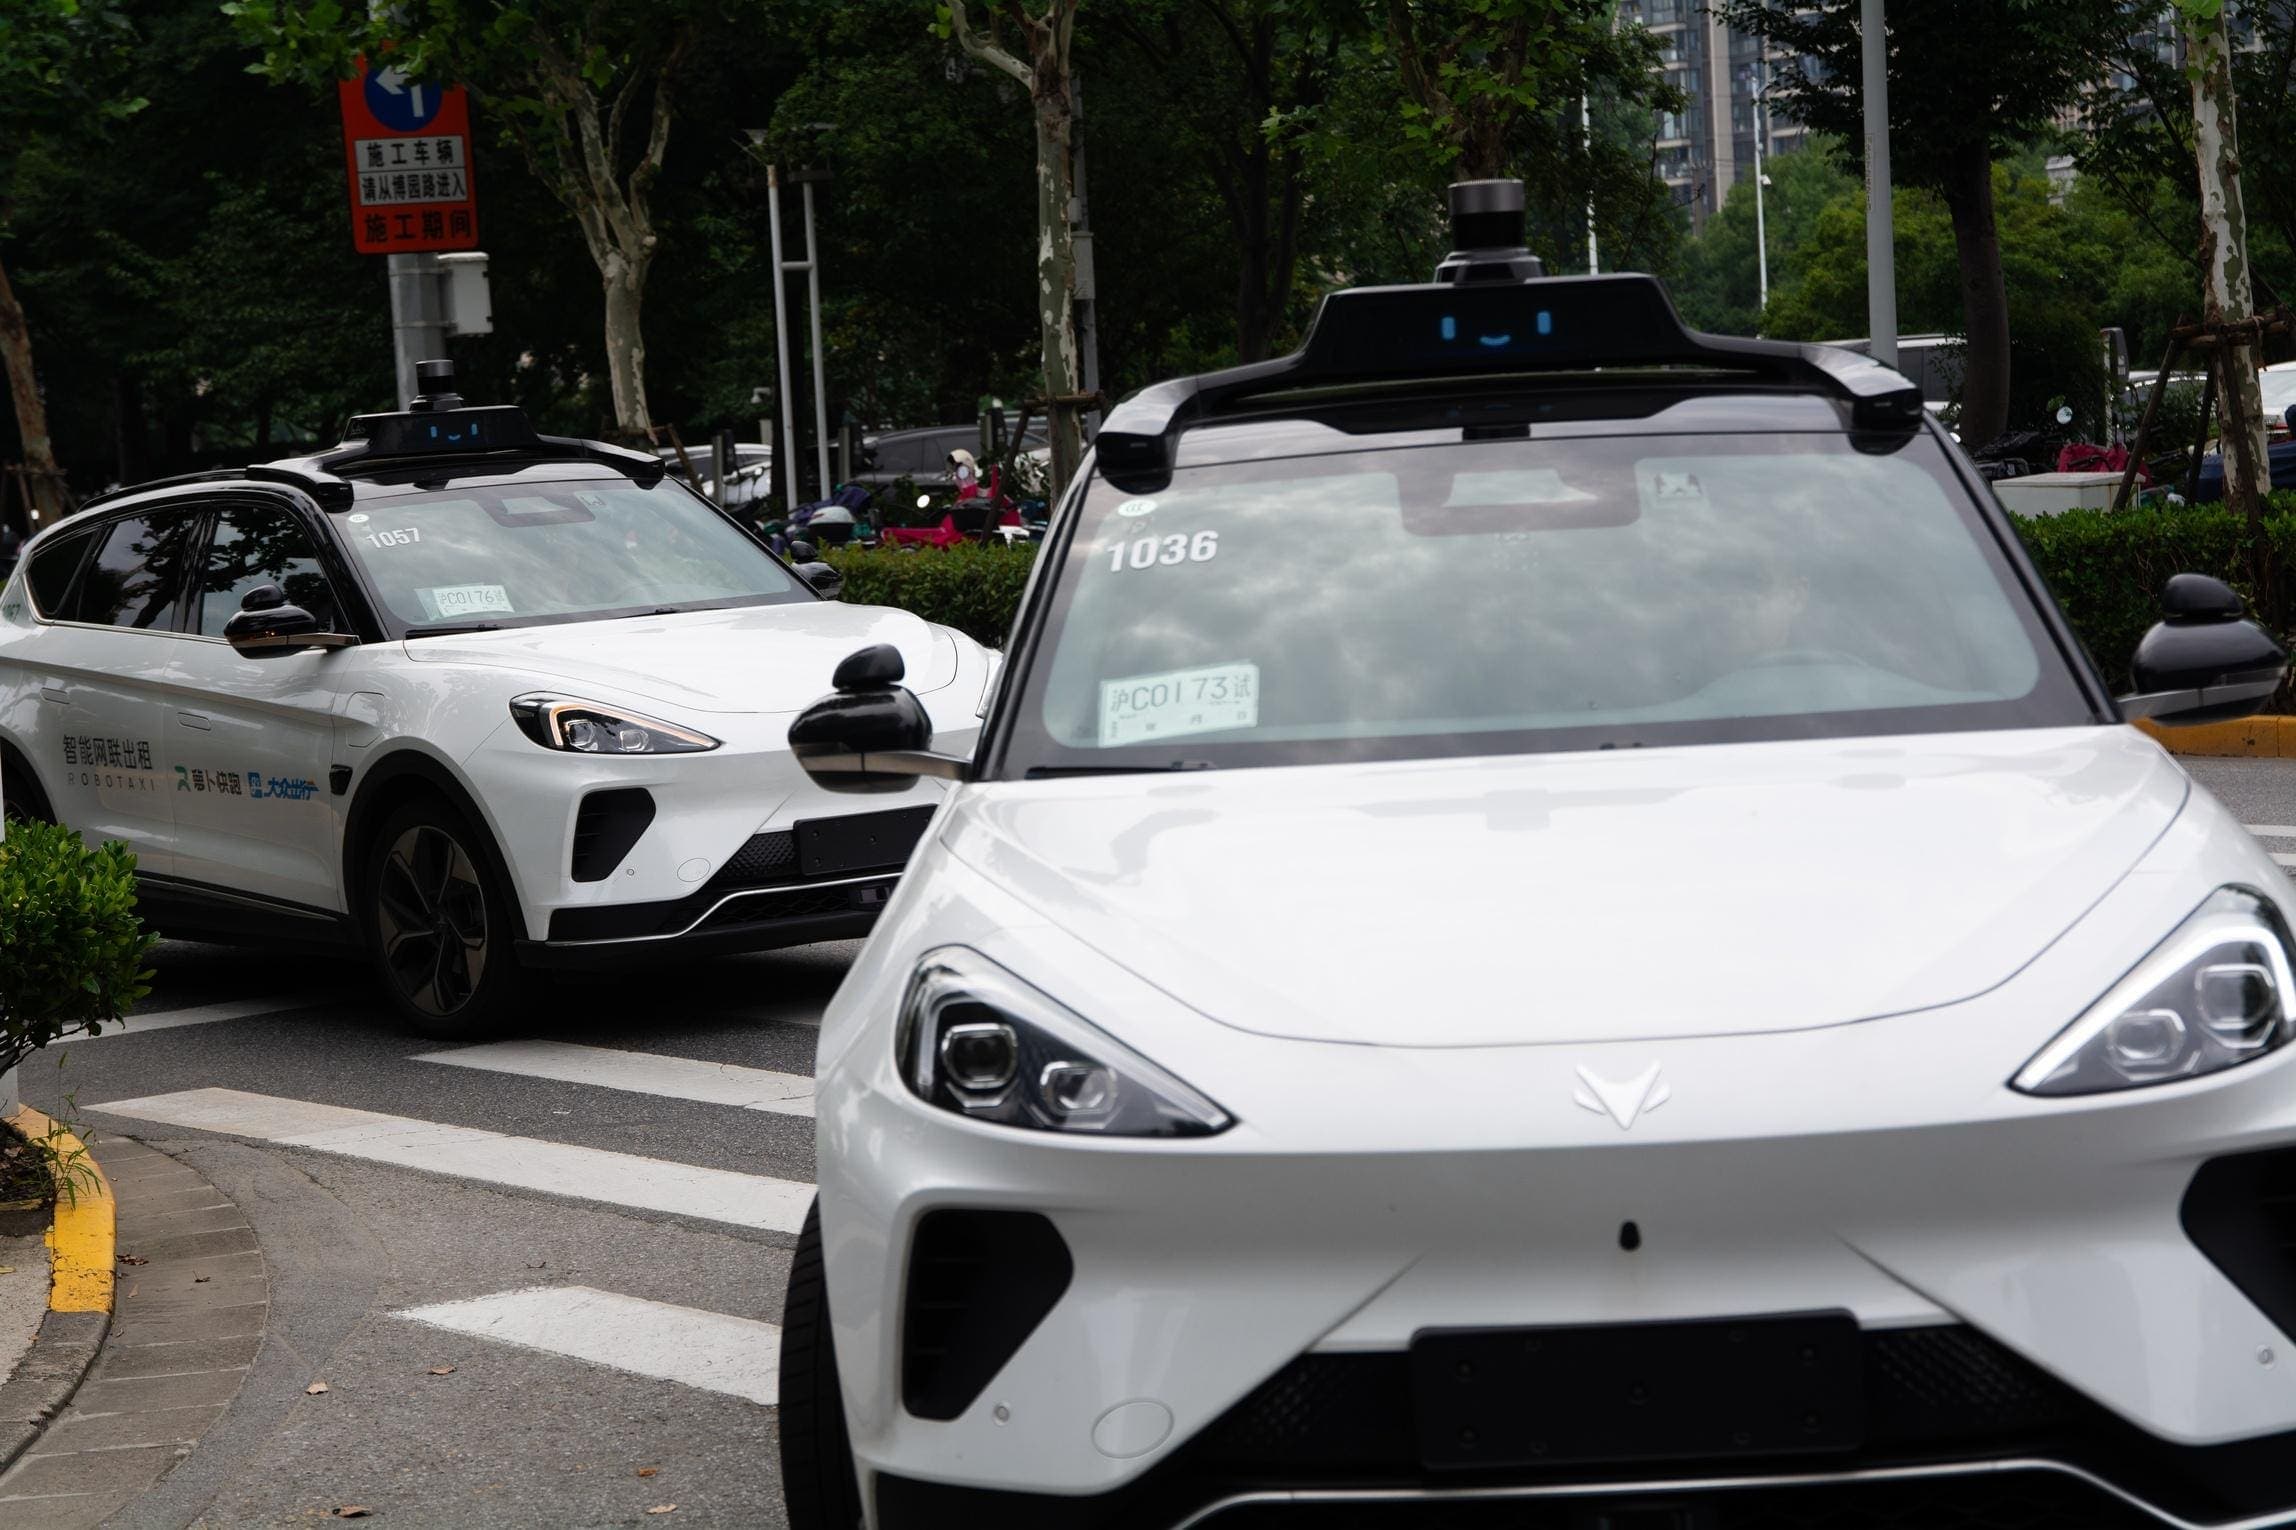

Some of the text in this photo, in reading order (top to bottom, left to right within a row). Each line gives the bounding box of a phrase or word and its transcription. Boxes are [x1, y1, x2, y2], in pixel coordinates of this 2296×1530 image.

[366, 139, 454, 167] 施工车辆
[362, 172, 466, 202] 请从博园路进入
[364, 208, 472, 243] 施工期间
[366, 527, 420, 549] 1057
[1106, 530, 1219, 573] 1036
[1110, 673, 1251, 713] 沪C0173试
[62, 733, 153, 770] 智能网联出租
[67, 771, 155, 791] ROBOTAXI
[263, 776, 321, 800] 大众出行
